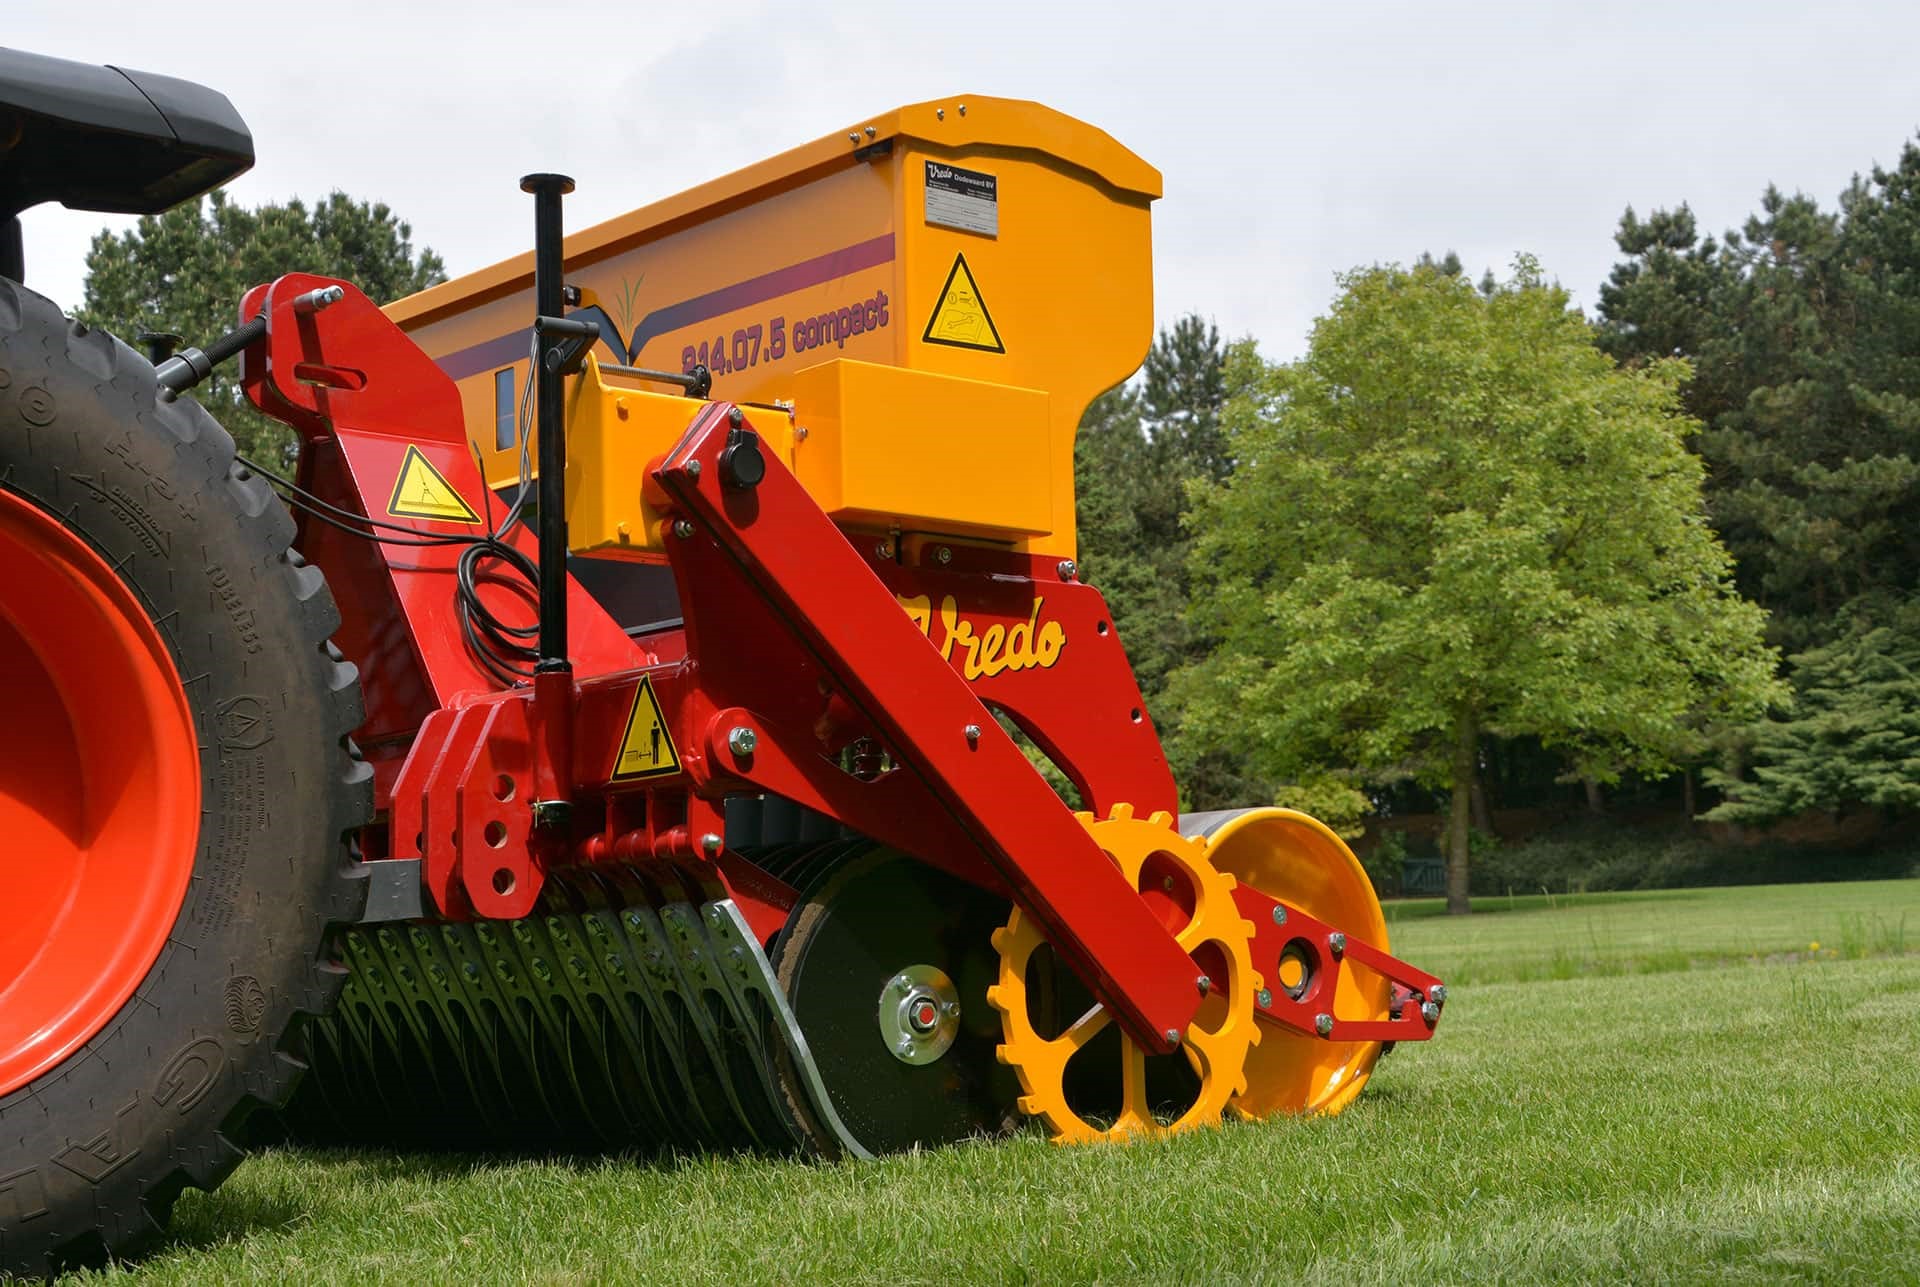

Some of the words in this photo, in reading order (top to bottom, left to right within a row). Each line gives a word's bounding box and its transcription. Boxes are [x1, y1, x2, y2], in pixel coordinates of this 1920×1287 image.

[927, 163, 953, 179] Vredo
[792, 289, 889, 353] compact
[110, 486, 164, 536] DIRECTION
[110, 506, 162, 558] ROTATION
[205, 564, 263, 656] TUBELESS
[896, 593, 1067, 681] Vredo
